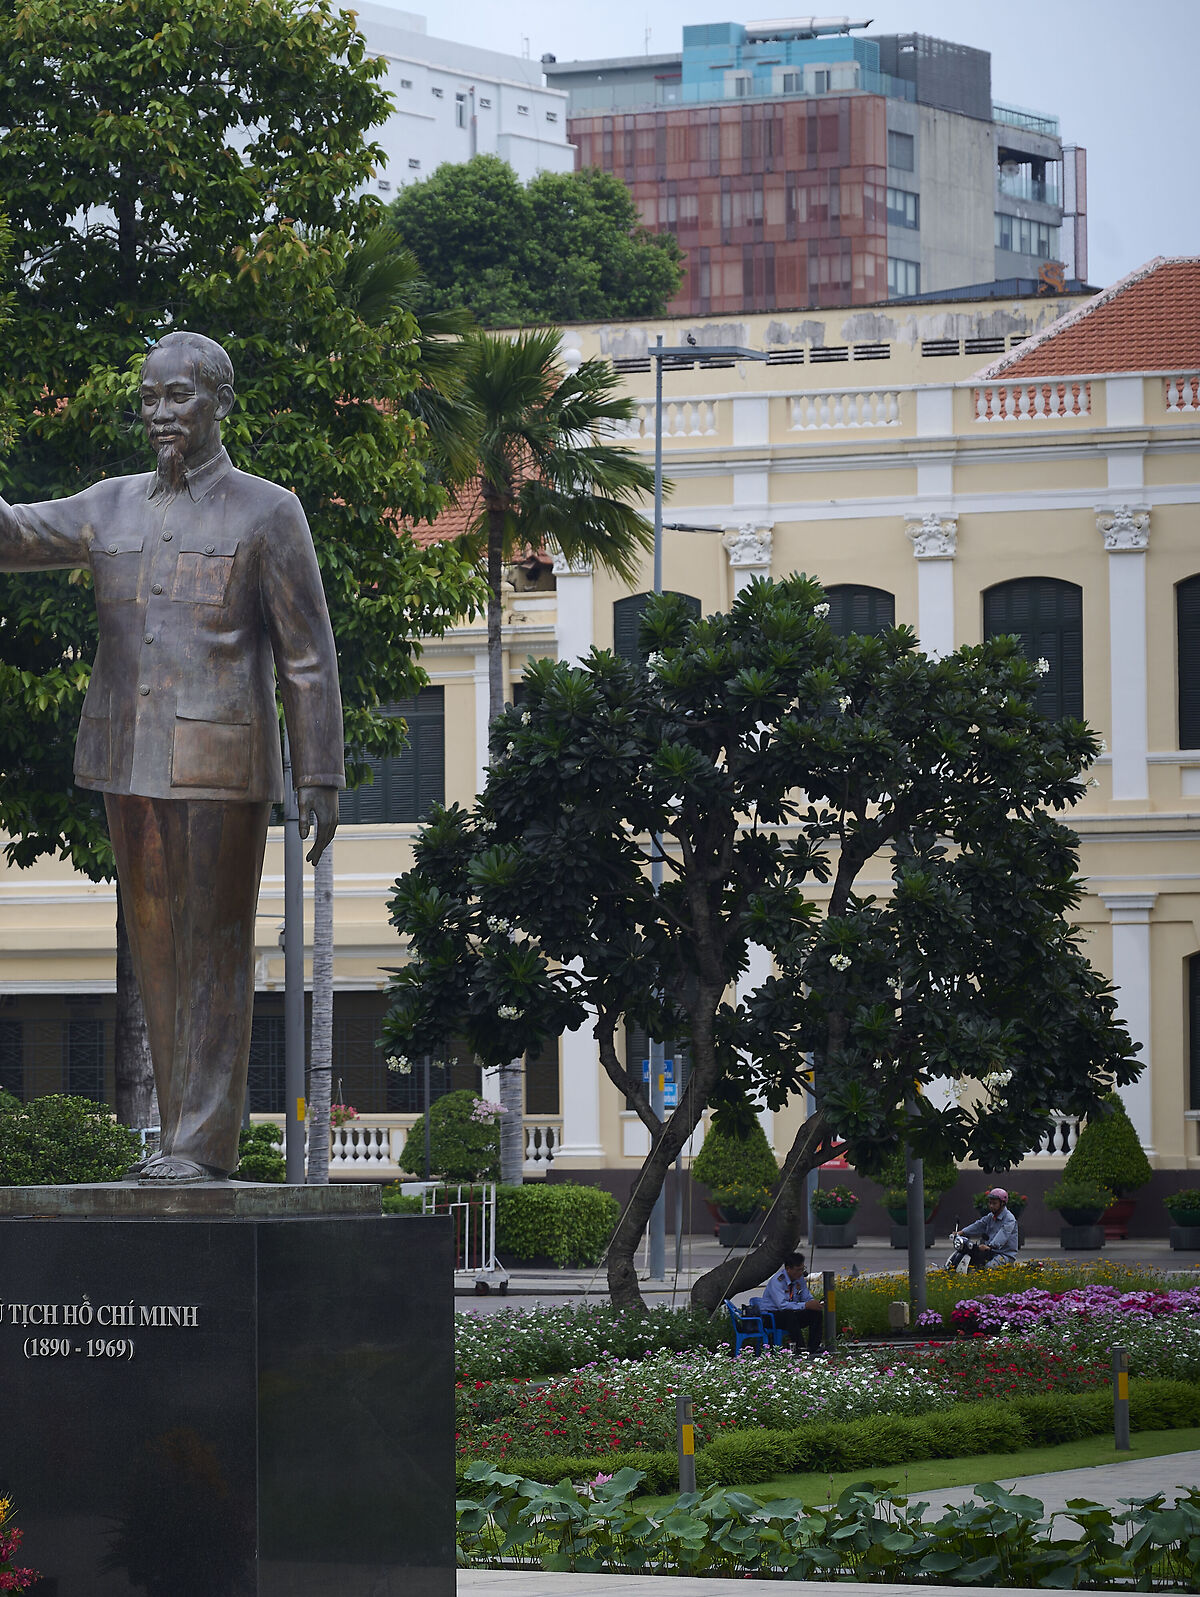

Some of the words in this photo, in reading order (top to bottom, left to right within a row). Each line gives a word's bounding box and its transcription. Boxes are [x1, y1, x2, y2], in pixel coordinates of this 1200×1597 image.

[8, 1304, 59, 1328] TỊCH
[62, 1294, 93, 1326] HỒ
[96, 1300, 135, 1326] CHÍ
[139, 1306, 199, 1327] MINH
[23, 1337, 70, 1359] (1890
[86, 1338, 135, 1361] 1969)
